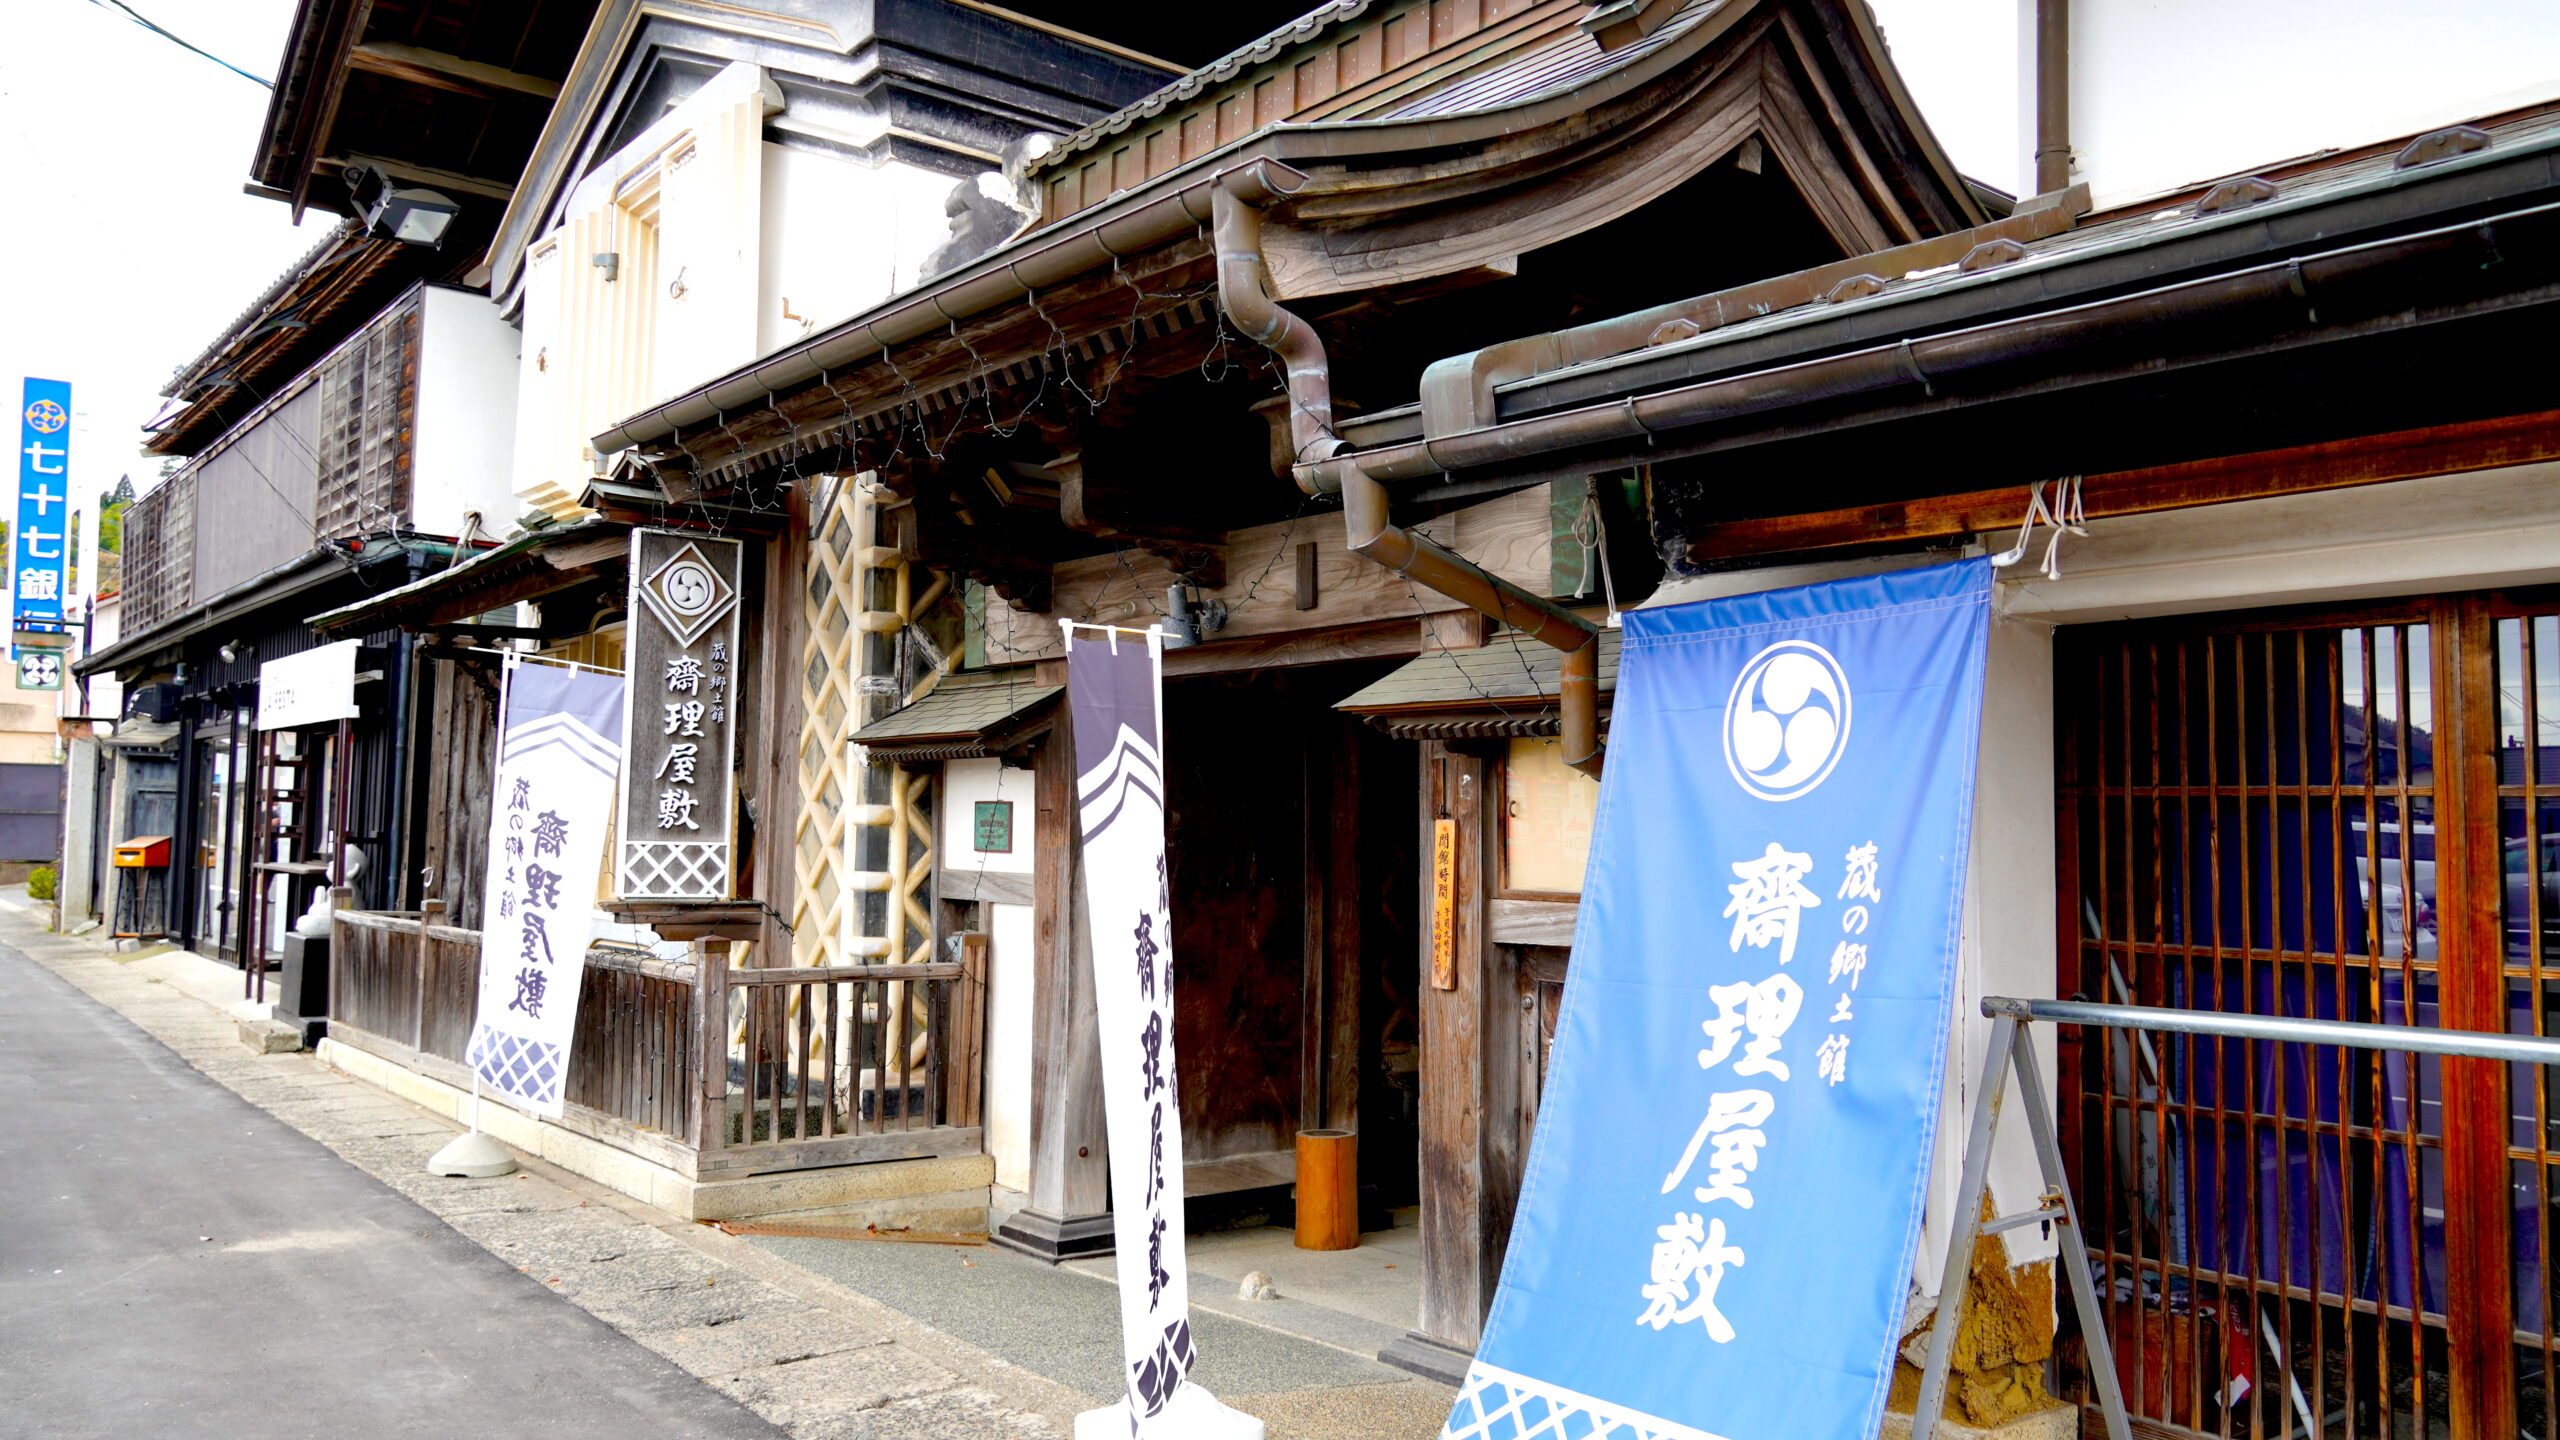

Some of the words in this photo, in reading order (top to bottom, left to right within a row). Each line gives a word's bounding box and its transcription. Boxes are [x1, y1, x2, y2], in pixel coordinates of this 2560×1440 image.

[709, 641, 729, 724] 蔵の郷土館
[1815, 840, 1881, 1088] 蔵の郷土館
